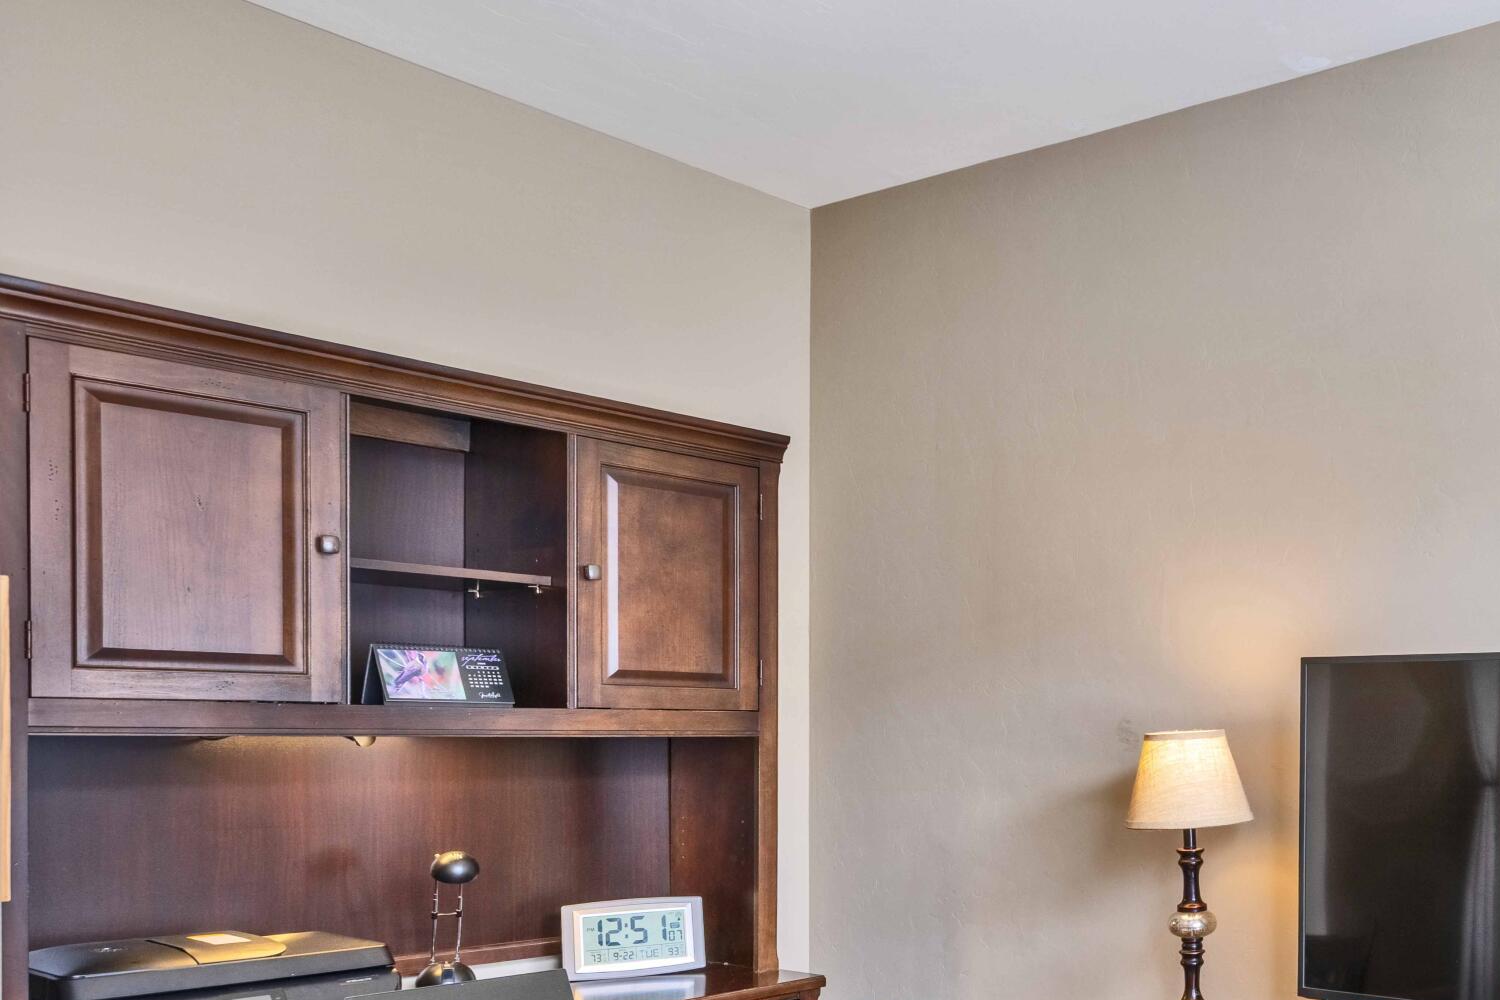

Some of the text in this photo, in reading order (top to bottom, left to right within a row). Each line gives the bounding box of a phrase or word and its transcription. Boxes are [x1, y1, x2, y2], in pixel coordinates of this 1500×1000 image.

[597, 914, 667, 947] 12:51
[669, 929, 683, 942] 07
[592, 953, 602, 963] 73
[613, 950, 634, 960] 9-22
[640, 949, 660, 959] TUE
